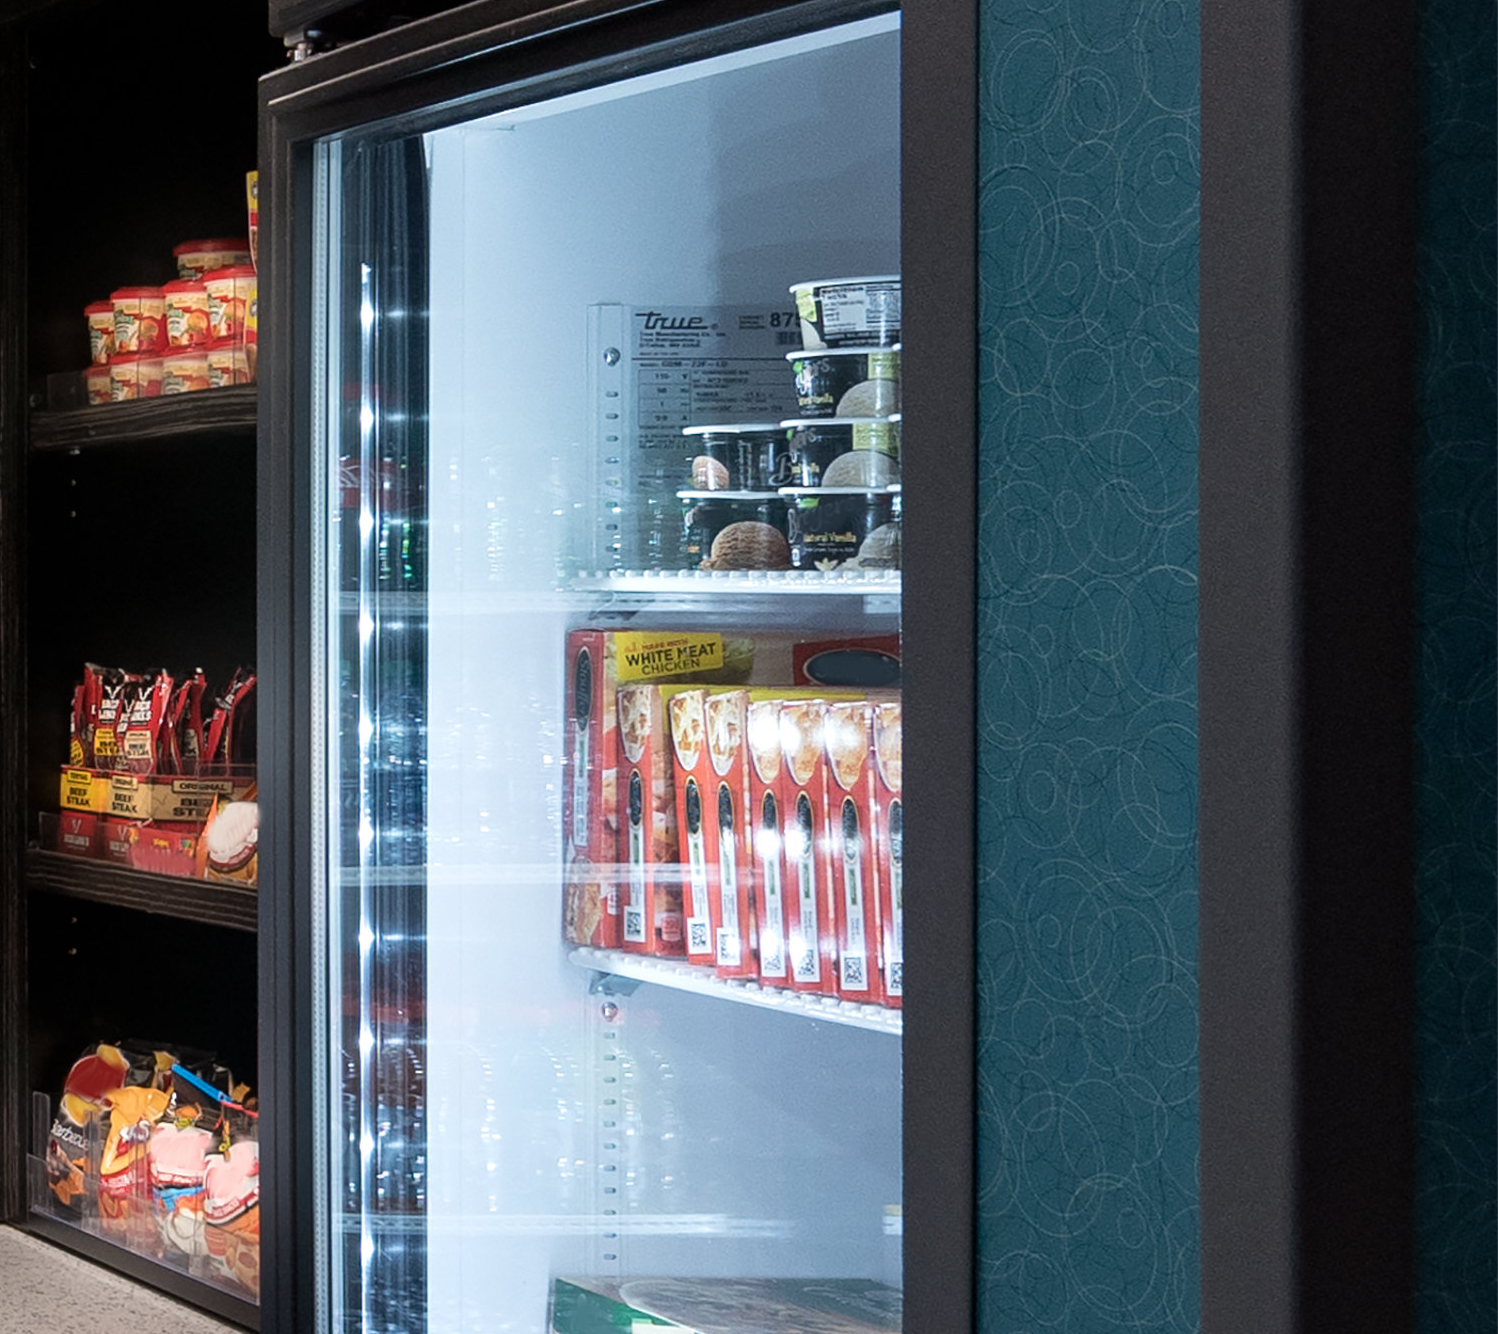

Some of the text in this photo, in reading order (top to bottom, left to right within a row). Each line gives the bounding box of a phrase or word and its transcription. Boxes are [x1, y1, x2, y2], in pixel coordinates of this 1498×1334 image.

[635, 310, 708, 330] true
[625, 642, 717, 667] WHITE MEAT
[641, 659, 701, 675] CHICKEN
[69, 787, 88, 796] BEEF
[114, 793, 132, 802] BEEF
